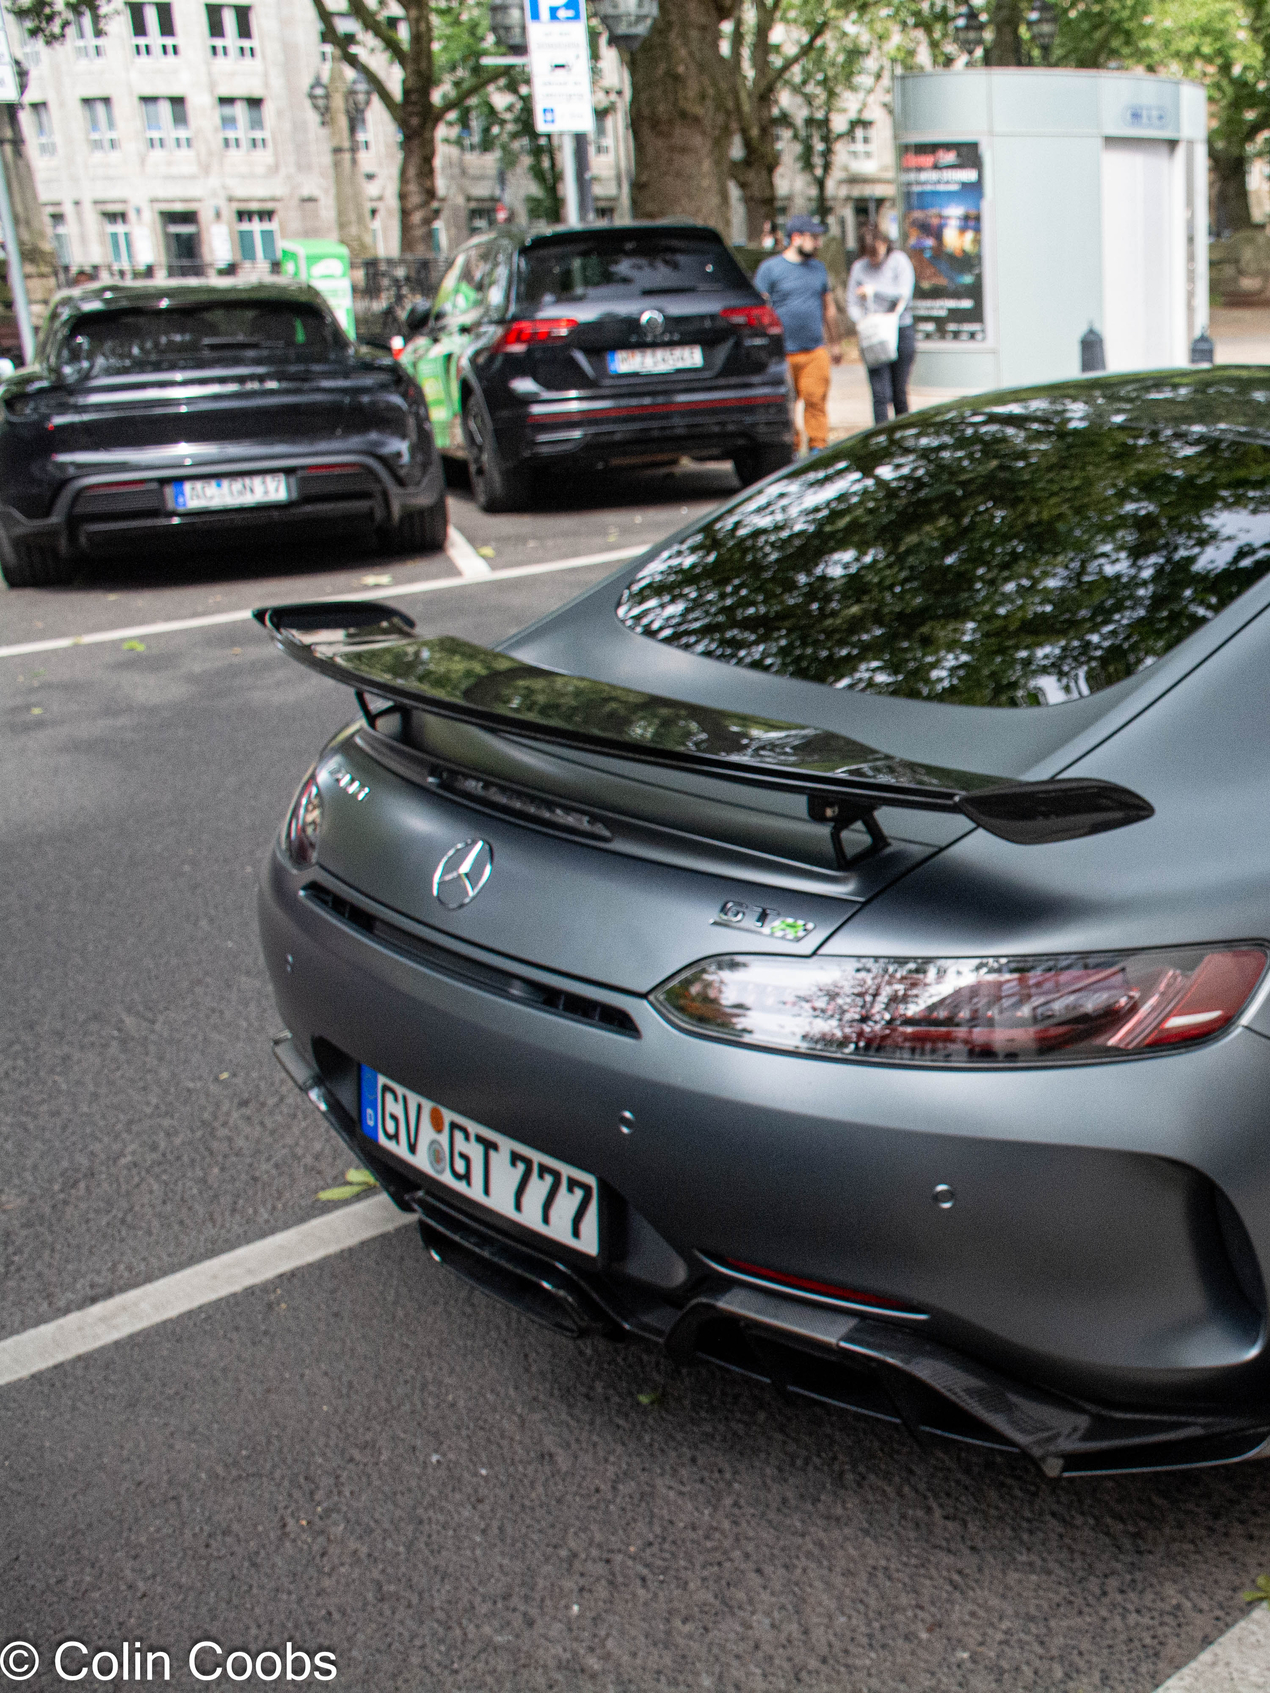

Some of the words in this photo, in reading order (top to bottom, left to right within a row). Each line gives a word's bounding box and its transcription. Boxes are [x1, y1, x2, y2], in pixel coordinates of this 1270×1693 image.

[381, 1082, 422, 1156] GV
[449, 1119, 500, 1198] GT
[510, 1148, 595, 1241] 777
